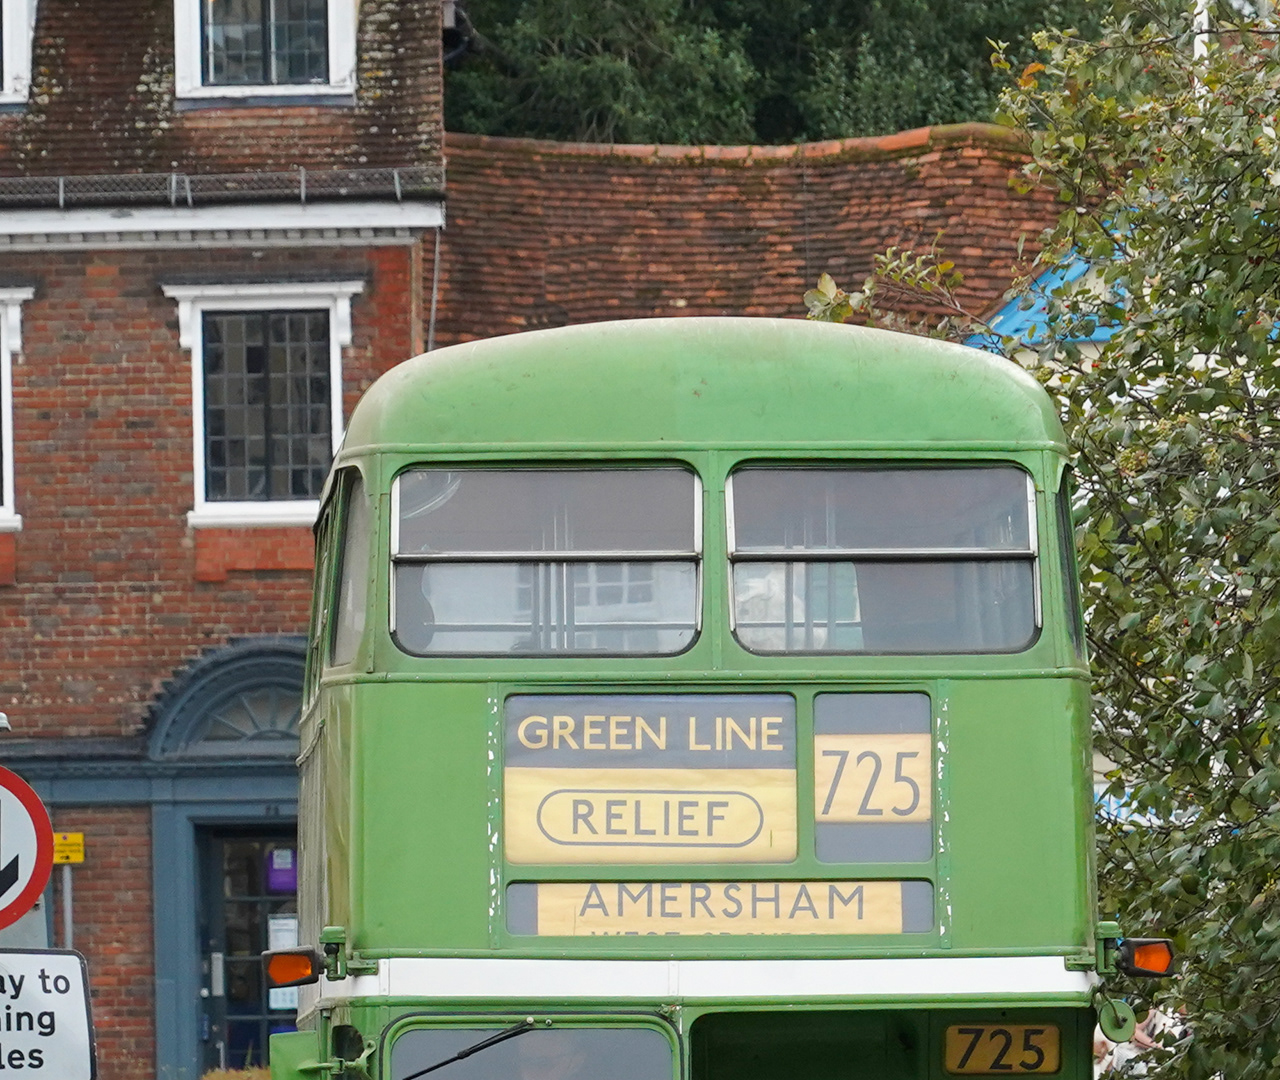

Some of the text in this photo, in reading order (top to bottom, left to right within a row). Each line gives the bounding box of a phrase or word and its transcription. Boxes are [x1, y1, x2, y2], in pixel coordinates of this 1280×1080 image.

[517, 714, 784, 751] GREEN LINE
[820, 749, 921, 817] 725
[571, 799, 730, 837] RELIEF
[579, 882, 865, 920] AMERSHAM
[38, 968, 71, 995] to
[956, 1027, 1046, 1071] 725
